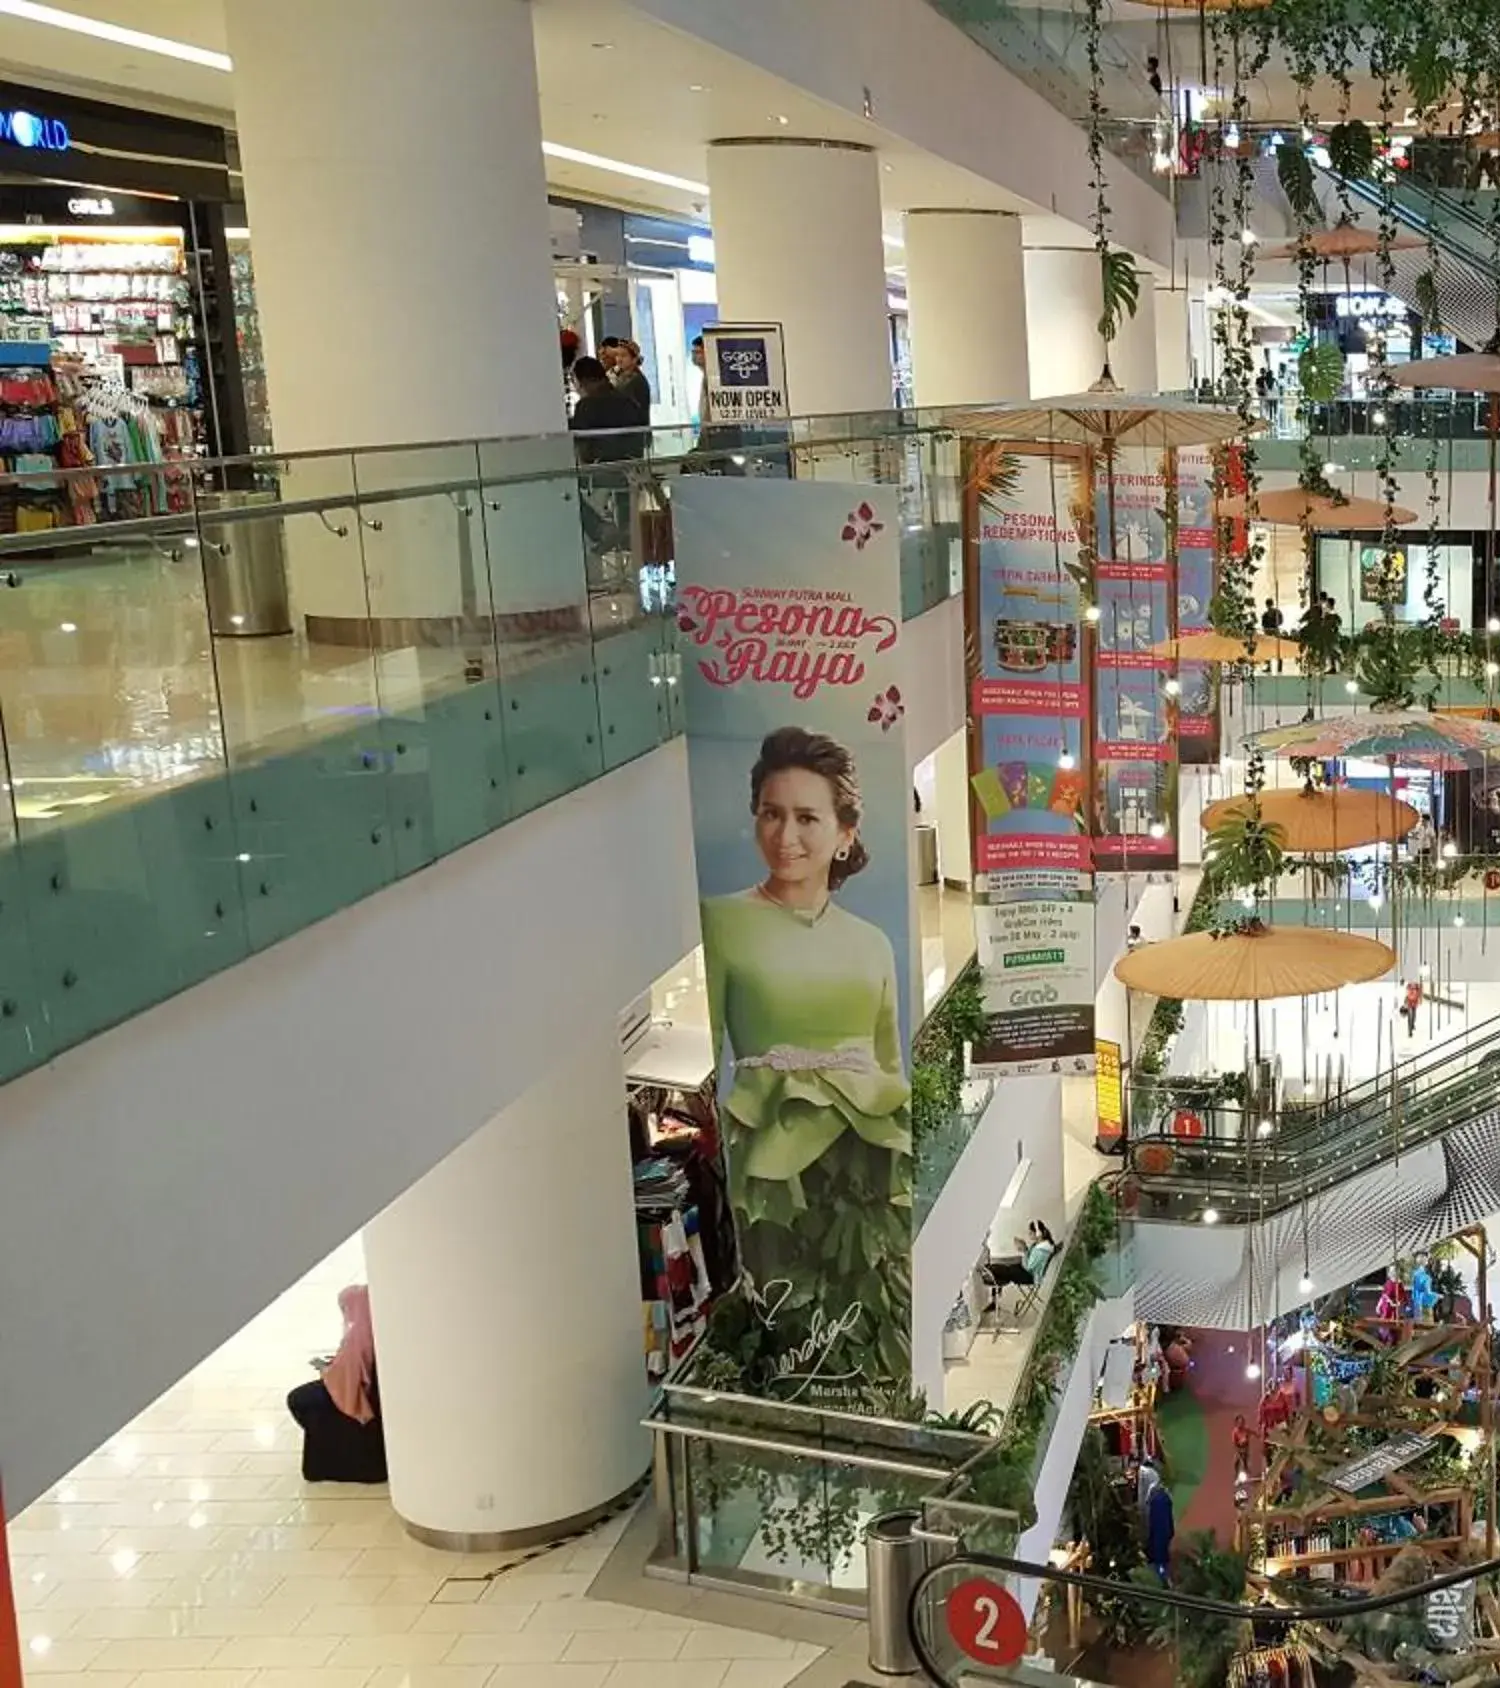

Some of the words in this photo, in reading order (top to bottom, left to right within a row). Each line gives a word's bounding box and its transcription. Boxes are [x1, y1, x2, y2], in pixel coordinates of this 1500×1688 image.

[710, 390, 742, 408] NOW
[745, 389, 781, 407] OPEN
[1003, 513, 1057, 527] PESONA
[983, 525, 1077, 543] REDEMPTIONS
[788, 588, 823, 601] PUTRA
[824, 590, 854, 602] MALL
[684, 586, 896, 650] Pesona
[699, 636, 866, 700] Raya
[1023, 930, 1041, 942] May
[1008, 983, 1059, 1007] Grab
[1184, 1119, 1191, 1135] 1
[810, 1384, 858, 1397] Marsha
[1395, 1437, 1431, 1455] The
[1427, 1579, 1473, 1637] etra
[973, 1596, 999, 1650] 2
